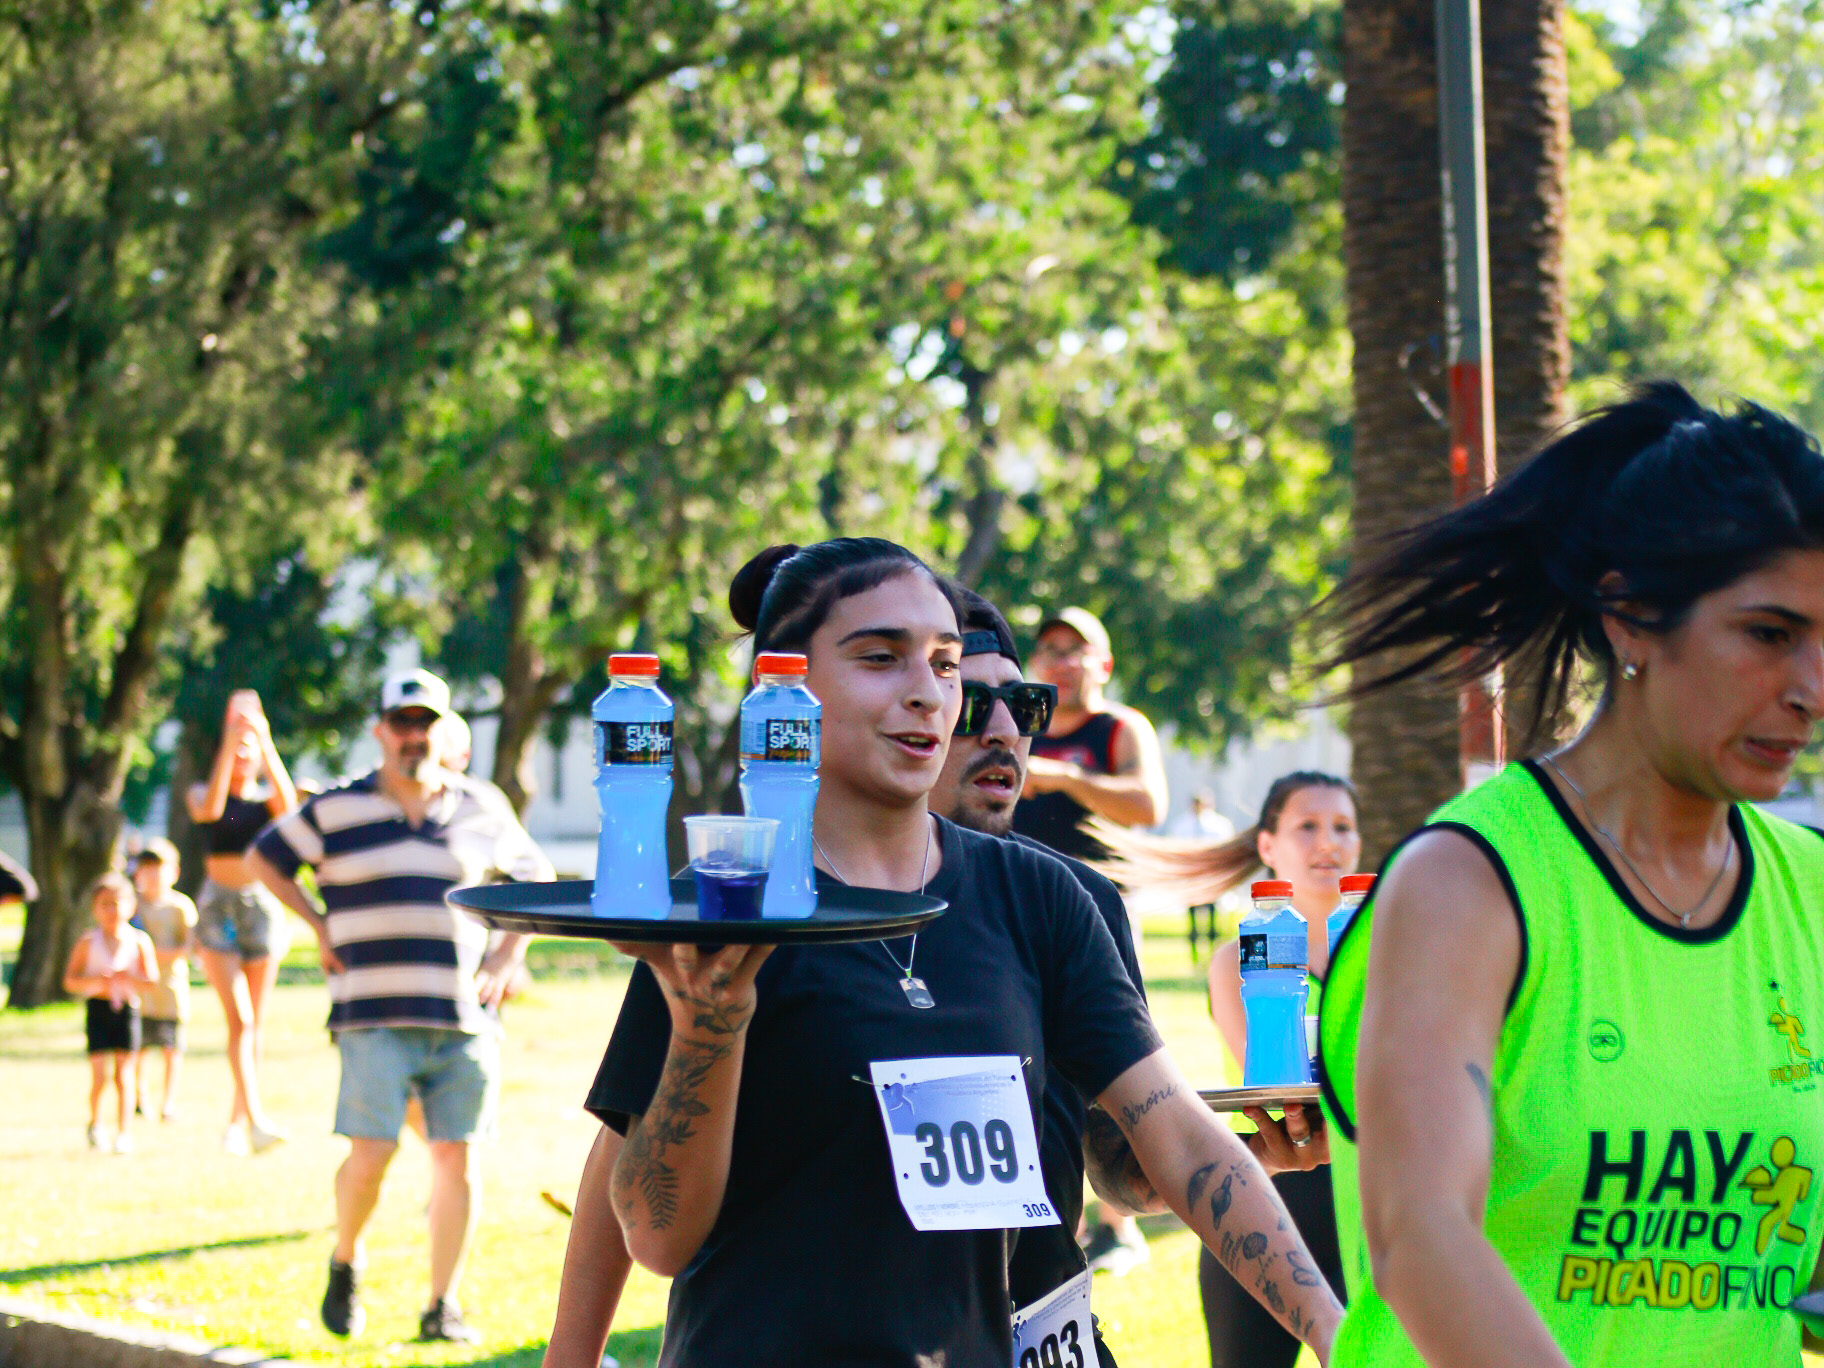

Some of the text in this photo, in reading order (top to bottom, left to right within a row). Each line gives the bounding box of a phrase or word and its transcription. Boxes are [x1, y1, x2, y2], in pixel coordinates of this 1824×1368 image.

[627, 725, 664, 739] FULL
[769, 722, 808, 737] FULL
[627, 738, 672, 752] SPORT
[769, 735, 816, 749] SPORT
[915, 1119, 1019, 1188] 309
[1581, 1130, 1755, 1204] HAY
[1022, 1203, 1051, 1218] 309
[1571, 1208, 1742, 1259] EQUIPO
